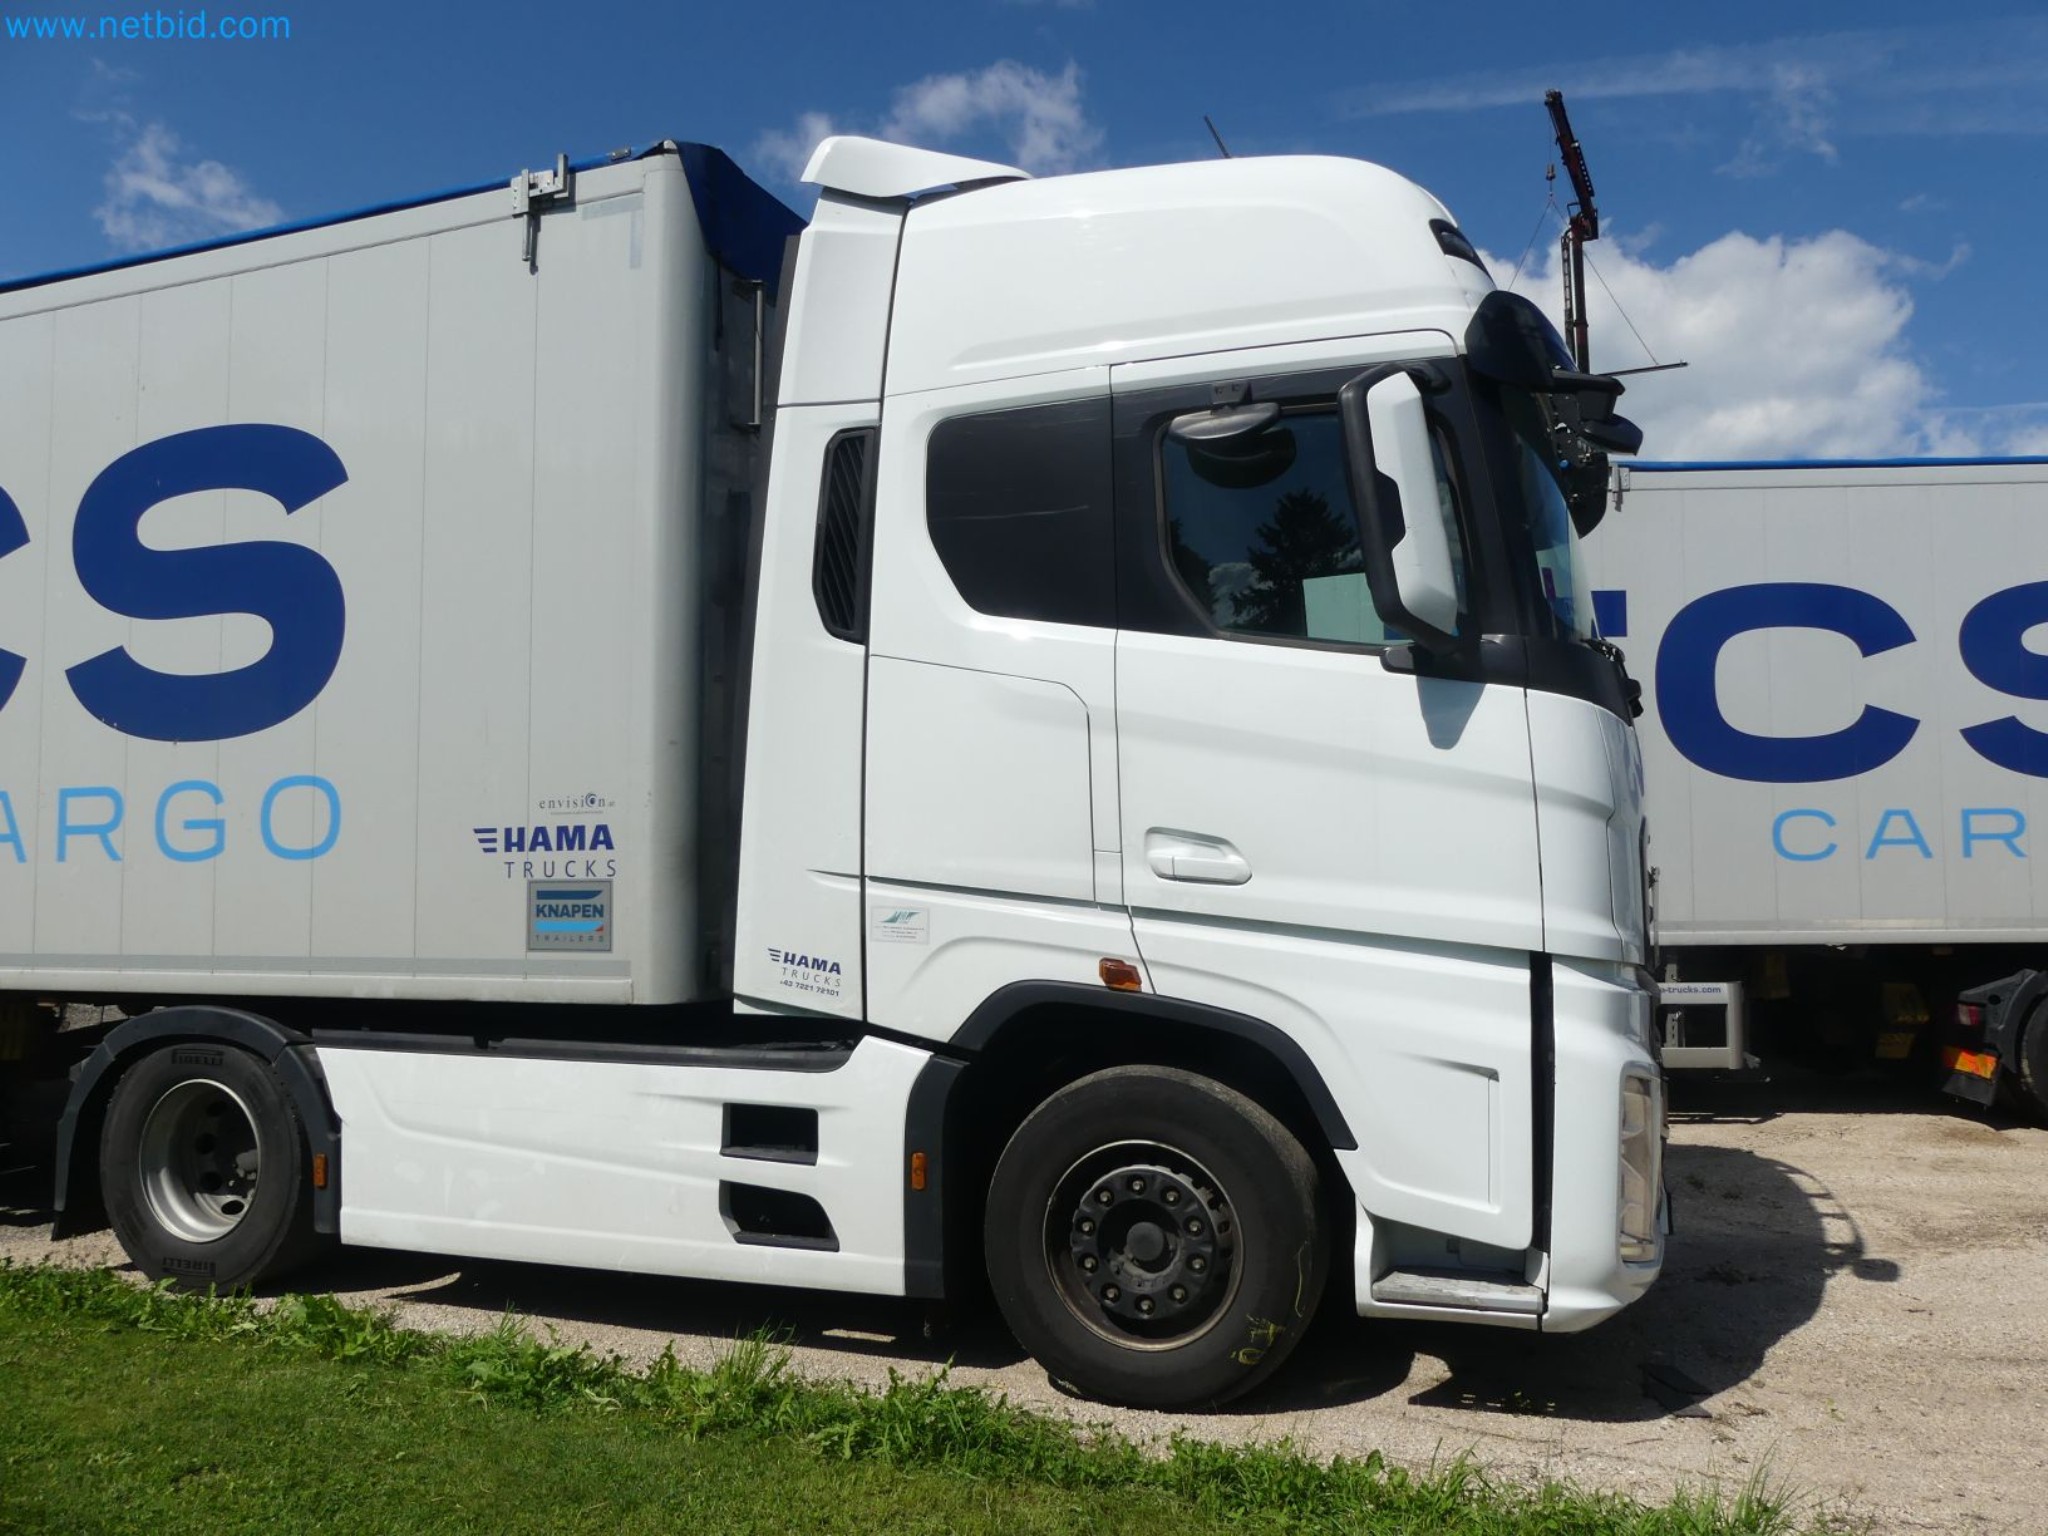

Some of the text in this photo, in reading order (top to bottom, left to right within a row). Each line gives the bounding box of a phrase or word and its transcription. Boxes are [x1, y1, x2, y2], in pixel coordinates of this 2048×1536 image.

[0, 423, 349, 742] S
[504, 824, 615, 853] HAMA
[1771, 808, 2028, 861] CAR
[504, 859, 616, 879] TRUCKS
[536, 904, 604, 918] KNAPEN
[783, 951, 841, 975] HAMA
[781, 967, 841, 987] TRUCKS
[171, 1048, 225, 1065] PIRELLI
